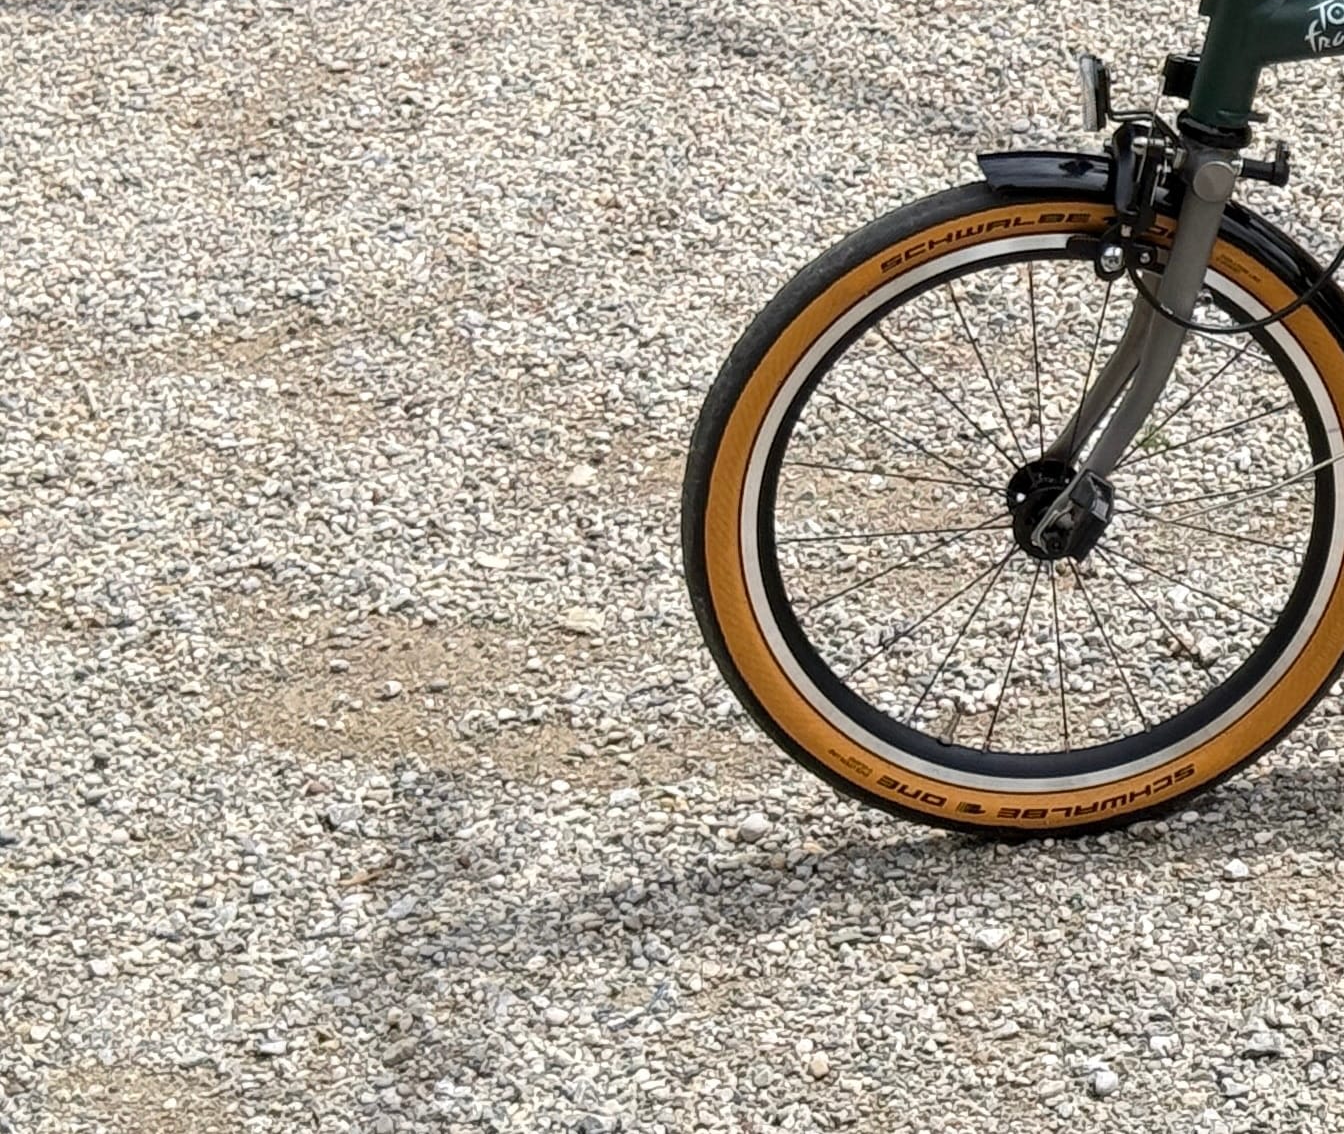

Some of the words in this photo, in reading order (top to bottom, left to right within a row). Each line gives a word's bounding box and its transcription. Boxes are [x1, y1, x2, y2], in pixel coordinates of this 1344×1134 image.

[879, 213, 1093, 274] SCHWALBE
[876, 774, 948, 807] ONE
[996, 762, 1195, 820] SCHWALBE
